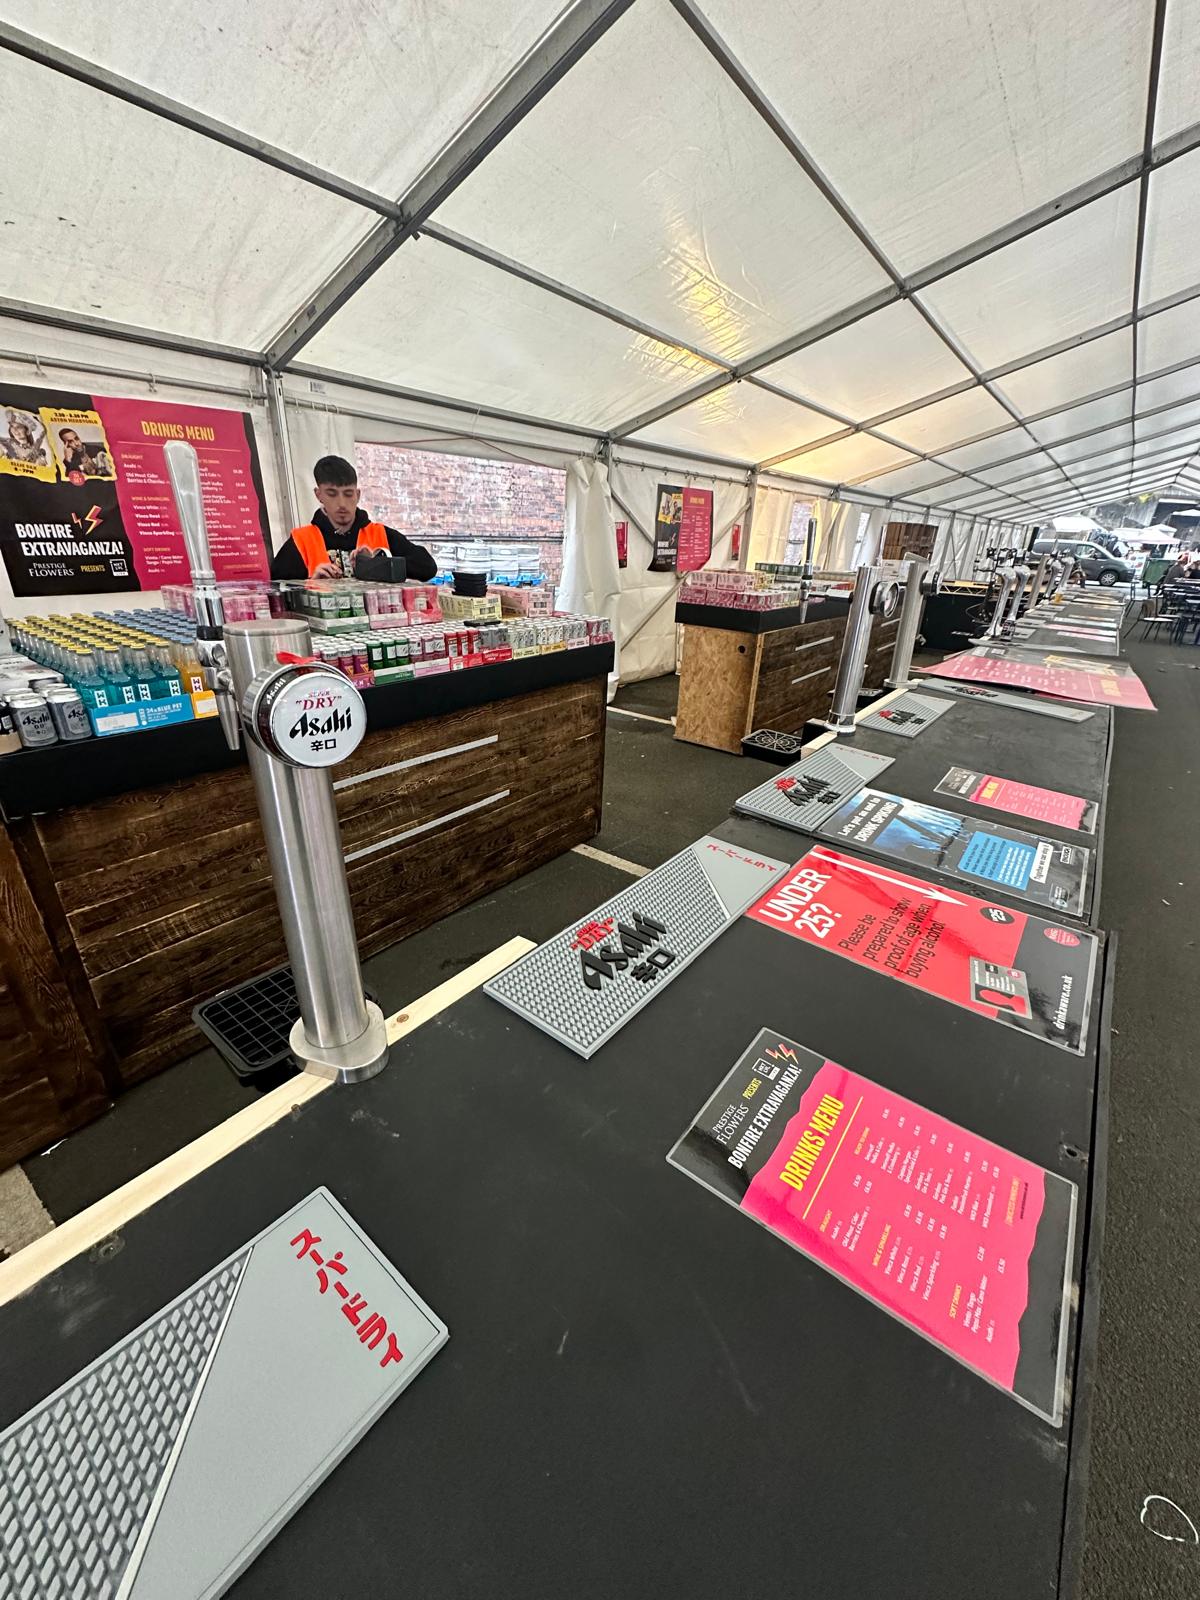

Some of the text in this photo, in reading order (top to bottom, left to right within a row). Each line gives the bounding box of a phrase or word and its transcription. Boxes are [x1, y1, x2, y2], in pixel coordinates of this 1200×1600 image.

[141, 421, 215, 442] DRINKS MENU
[14, 523, 74, 539] BONFIRE
[20, 541, 125, 556] EXTRAVAGANZA!
[28, 568, 75, 577] FLOWERS
[80, 564, 106, 572] PRESENTS
[289, 706, 352, 739] Asahi
[310, 738, 337, 752] 辛口
[853, 802, 898, 842] DRINK SPIKING
[759, 869, 832, 921] UNDER
[794, 903, 842, 938] 25?
[837, 914, 877, 951] Please be
[862, 899, 911, 962] prepared to show
[883, 904, 932, 971] proof of age when
[580, 911, 667, 991] Asahi
[630, 947, 676, 984] 辛口
[901, 918, 945, 979] buying alcohol
[1053, 975, 1073, 1030] drinkaware.co.uk
[742, 1078, 762, 1100] PRESENTS
[712, 1104, 736, 1133] PRESTIGE
[716, 1103, 749, 1145] FLOWERS
[728, 1063, 801, 1169] BONFIRE EXTRAVAGANZA!
[779, 1094, 844, 1191] DRINKS MENU
[289, 1227, 404, 1369] スーパードライ
